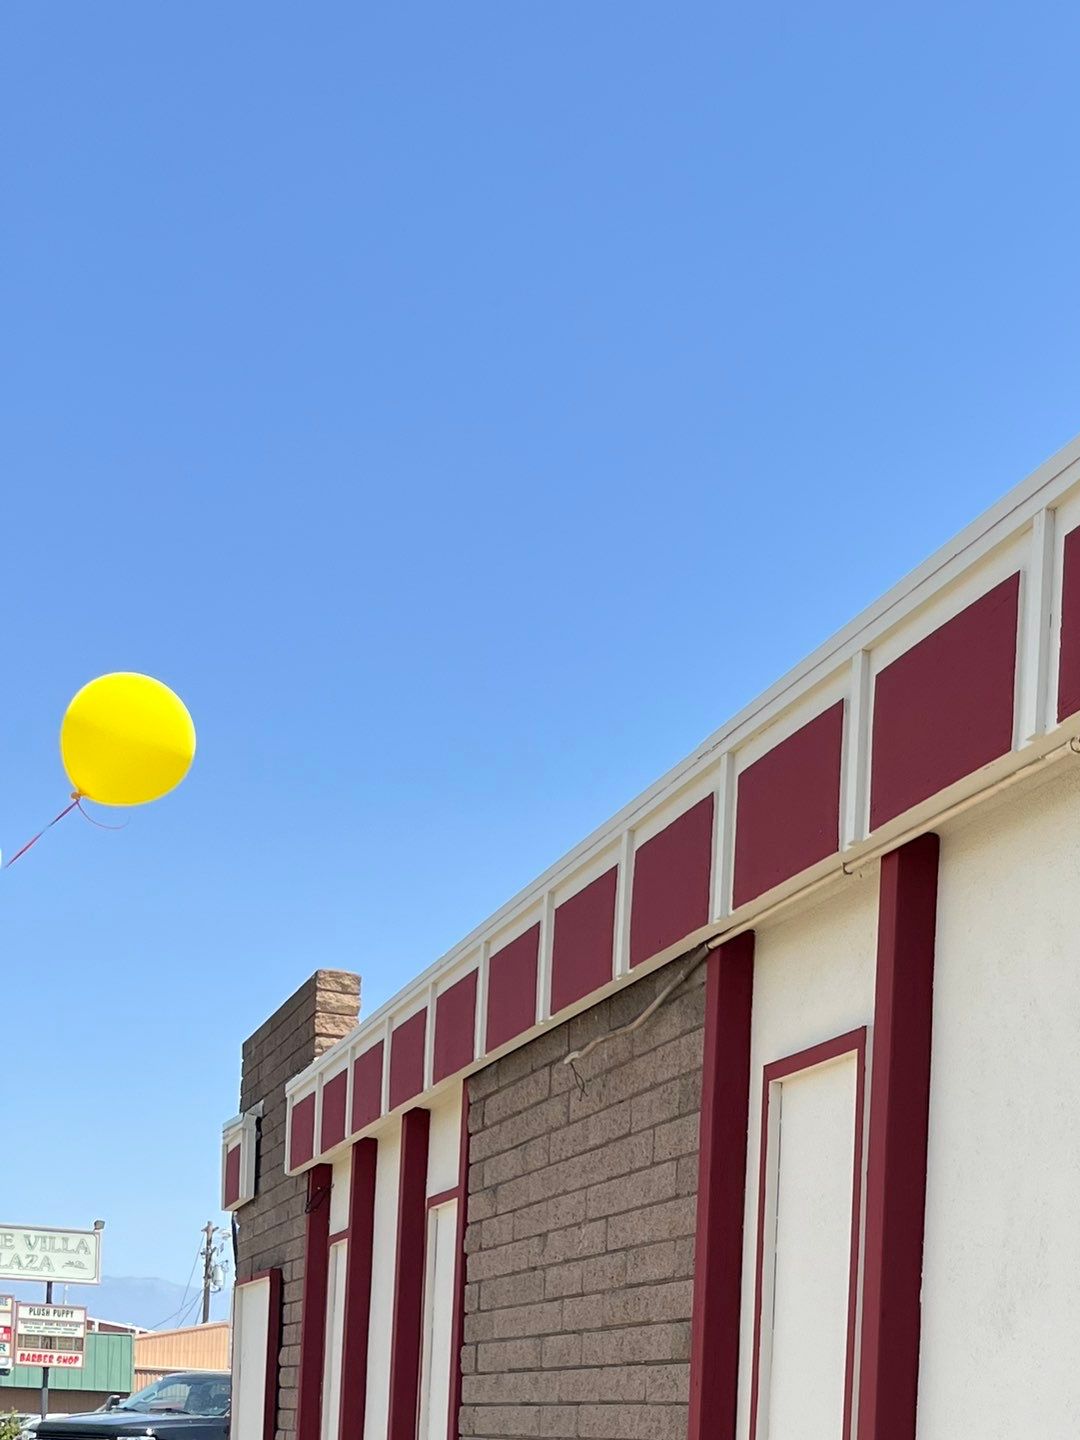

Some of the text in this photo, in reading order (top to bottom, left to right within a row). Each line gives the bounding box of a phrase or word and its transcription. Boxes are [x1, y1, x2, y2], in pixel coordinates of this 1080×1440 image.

[23, 1234, 91, 1255] VILLA
[28, 1307, 74, 1318] PLUSH PUPPY
[20, 1352, 80, 1365] BARBER SHOP
